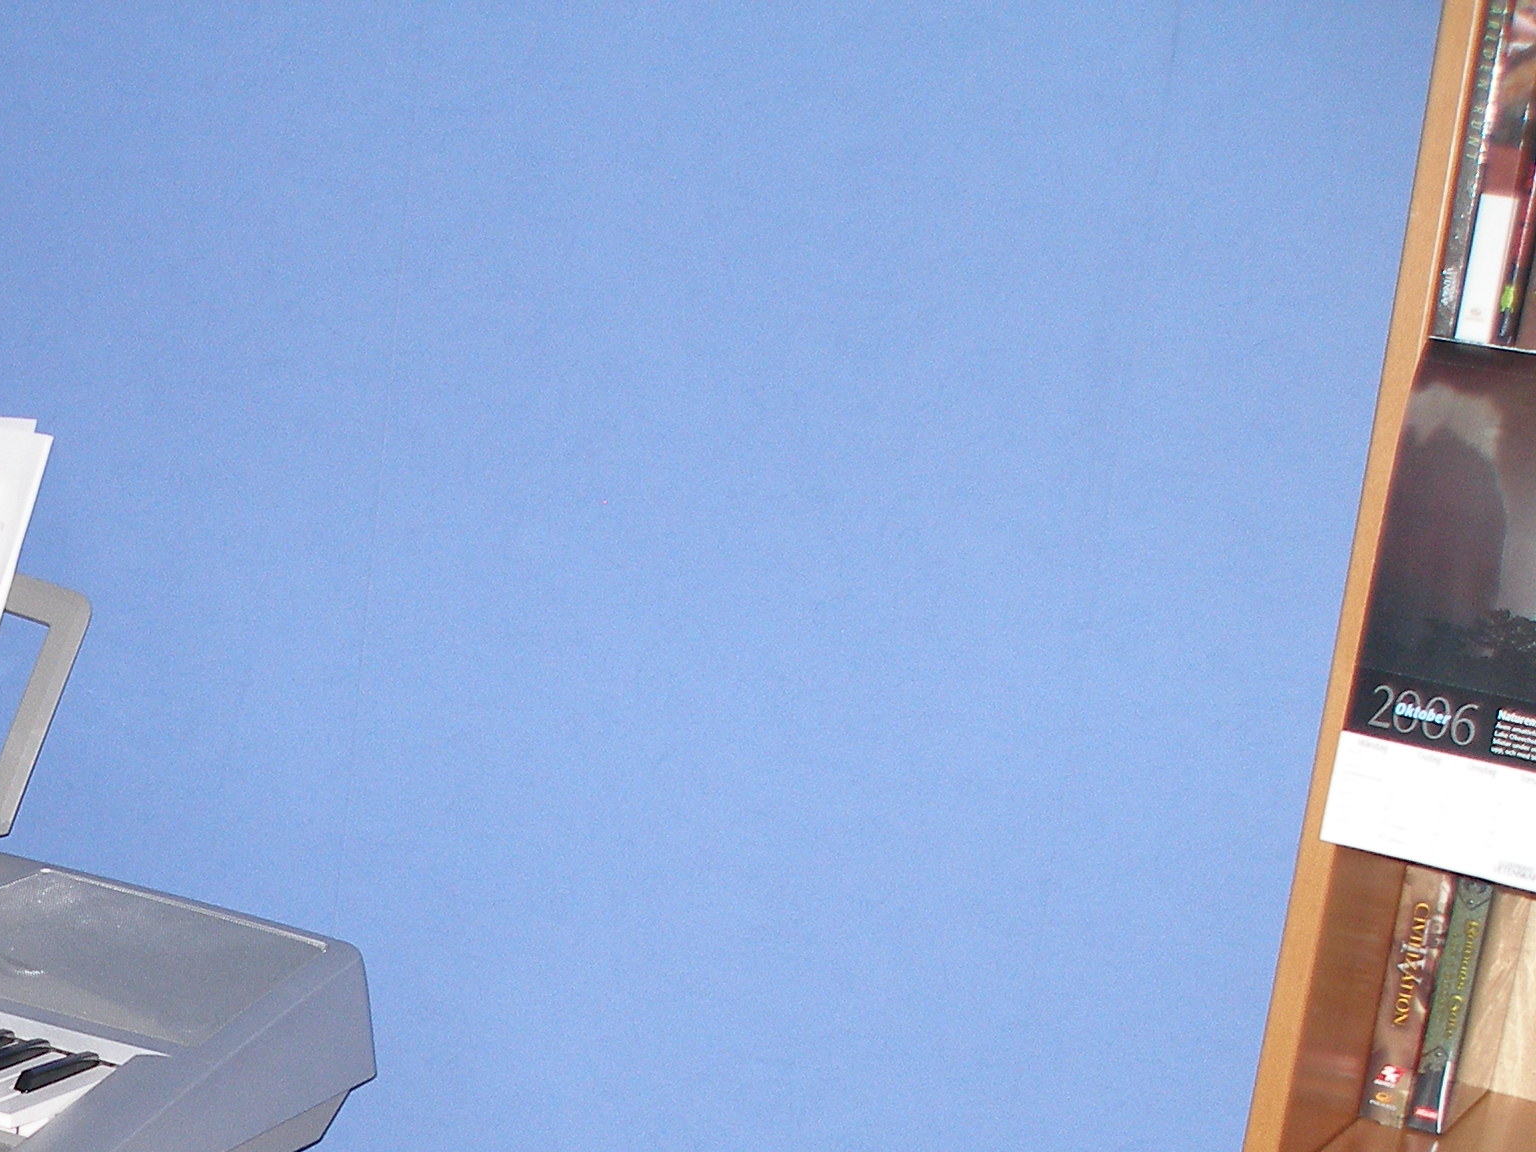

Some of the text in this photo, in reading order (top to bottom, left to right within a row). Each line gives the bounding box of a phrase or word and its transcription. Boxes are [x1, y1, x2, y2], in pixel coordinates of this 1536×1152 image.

[1367, 684, 1480, 746] 2006
[1394, 702, 1452, 726] Oktober
[1394, 902, 1430, 1026] CIVILIZATION
